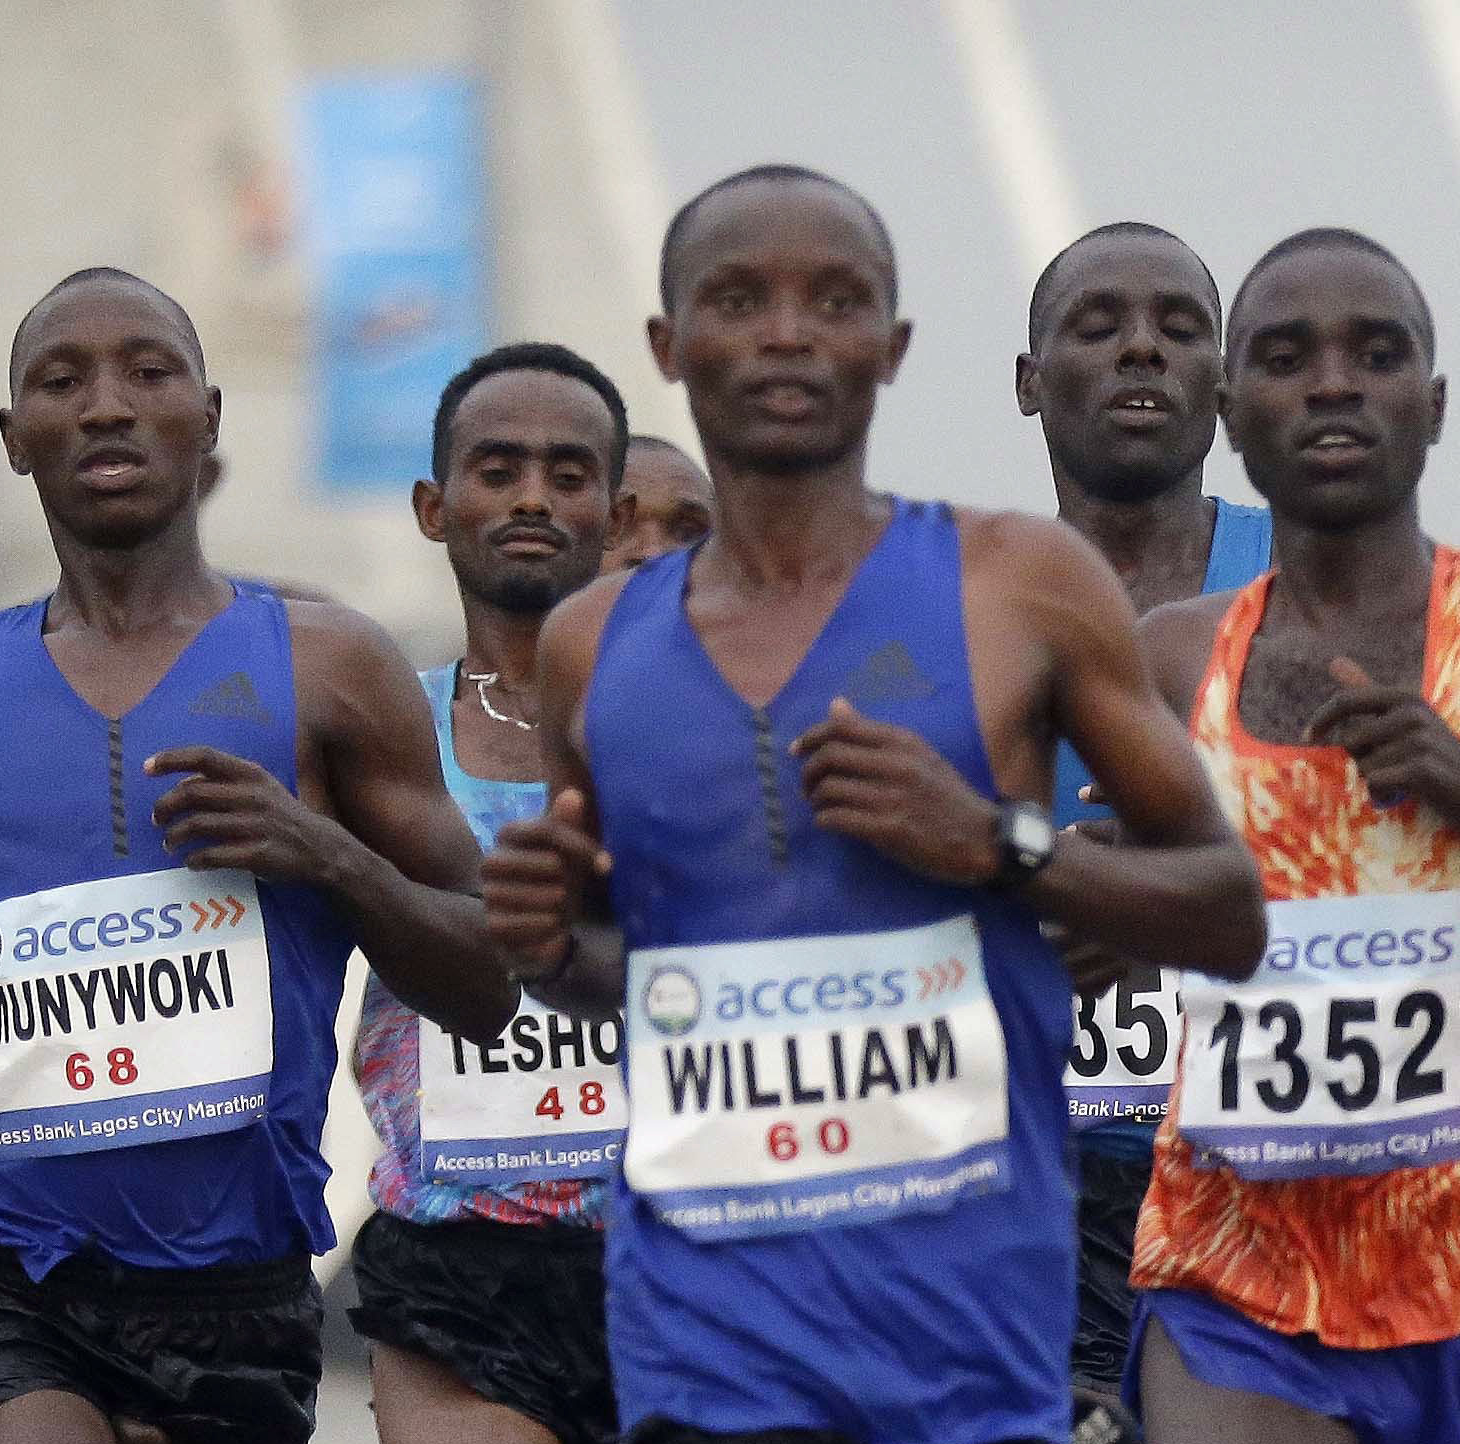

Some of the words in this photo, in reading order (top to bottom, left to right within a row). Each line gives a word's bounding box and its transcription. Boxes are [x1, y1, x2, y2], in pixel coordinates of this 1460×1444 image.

[13, 902, 183, 961] access
[1266, 924, 1457, 971] access
[716, 967, 910, 1020] access
[1069, 968, 1184, 1078] 35
[663, 1015, 959, 1114] WILLIAM
[34, 1122, 76, 1142] Bank
[79, 1113, 139, 1137] Lagos
[142, 1107, 184, 1128] City
[188, 1093, 265, 1121] Marathon
[434, 1154, 494, 1171] Access
[497, 1152, 541, 1168] Bank
[546, 1147, 601, 1166] Lagos
